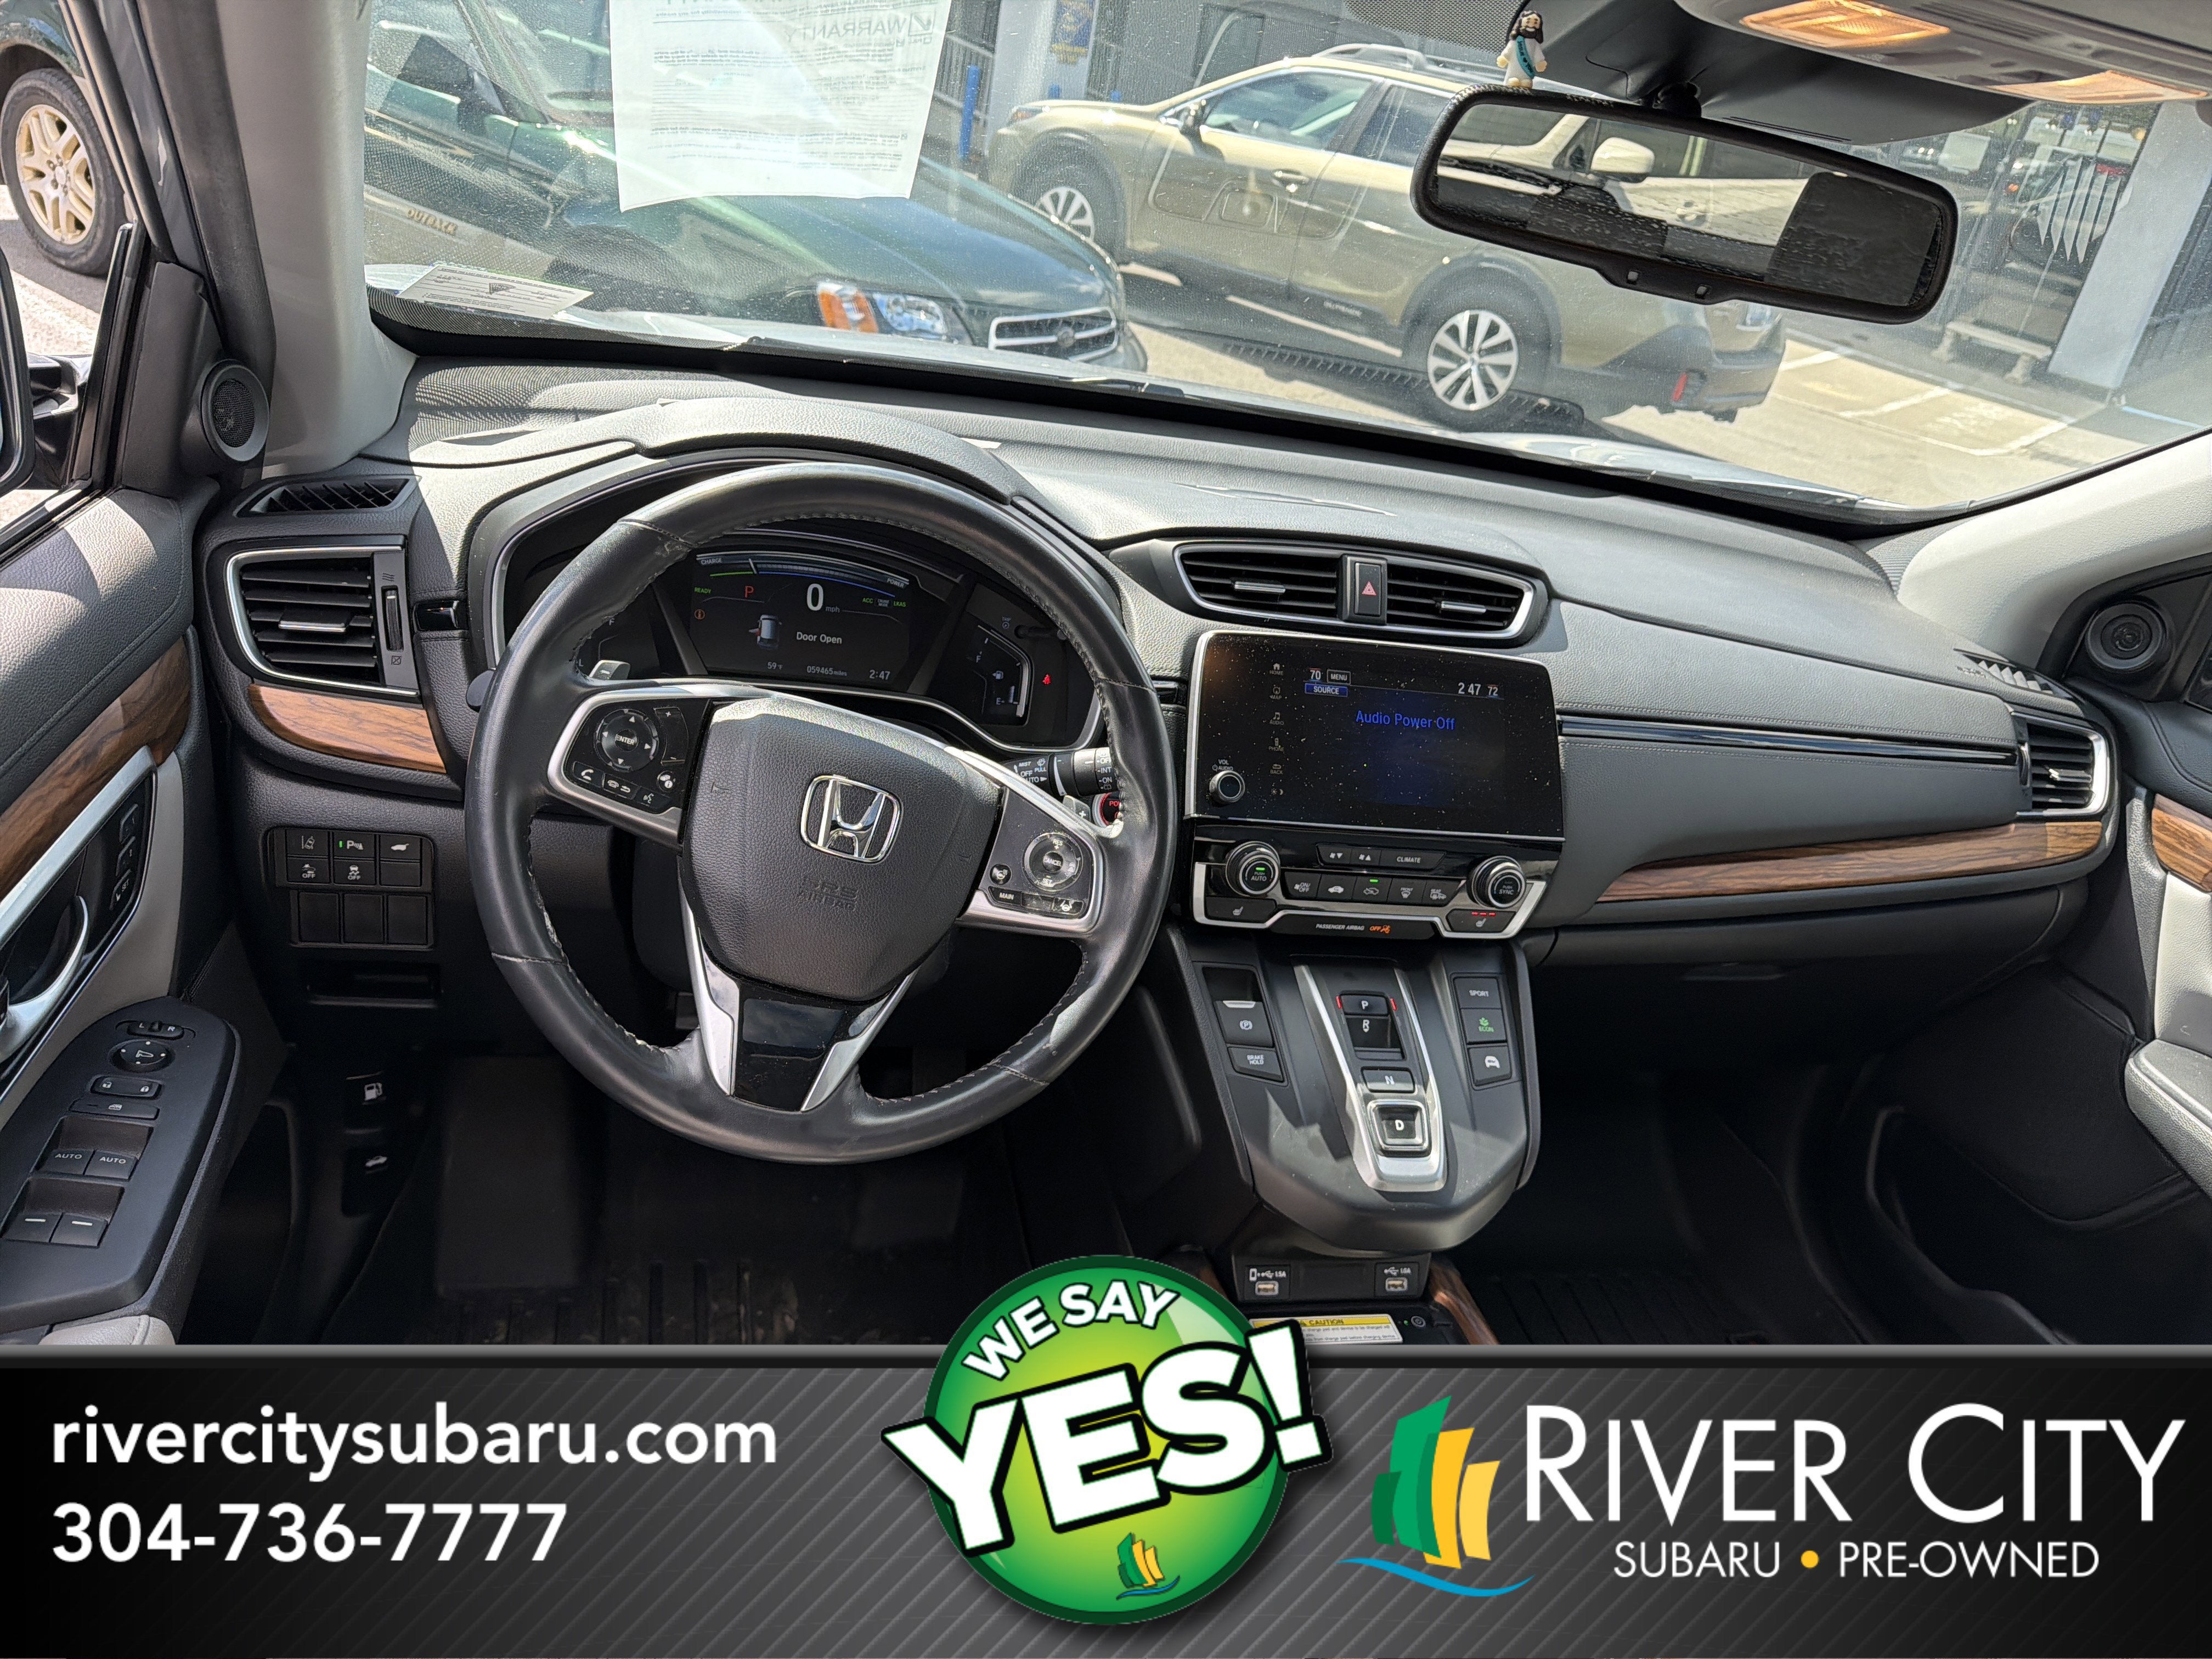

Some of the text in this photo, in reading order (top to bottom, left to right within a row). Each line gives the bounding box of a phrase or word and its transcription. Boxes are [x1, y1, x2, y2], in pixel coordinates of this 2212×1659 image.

[887, 578, 905, 589] POWER
[745, 585, 754, 598] P
[806, 583, 824, 611] 0
[796, 631, 843, 645] Door Open
[975, 655, 981, 663] F
[869, 669, 891, 680] 2:47
[1310, 670, 1348, 681] 70 MENU
[1313, 686, 1340, 695] SOURCE
[1488, 686, 1499, 696] 72
[1356, 710, 1455, 730] Audio Power Off
[615, 733, 636, 746] ENTER
[1052, 838, 1063, 847] RES
[998, 892, 1014, 900] MAIN
[1361, 1000, 1369, 1010] P
[1363, 1019, 1370, 1029] R
[1384, 1075, 1395, 1085] N
[1395, 1119, 1404, 1131] D
[99, 1156, 126, 1164] AUTO
